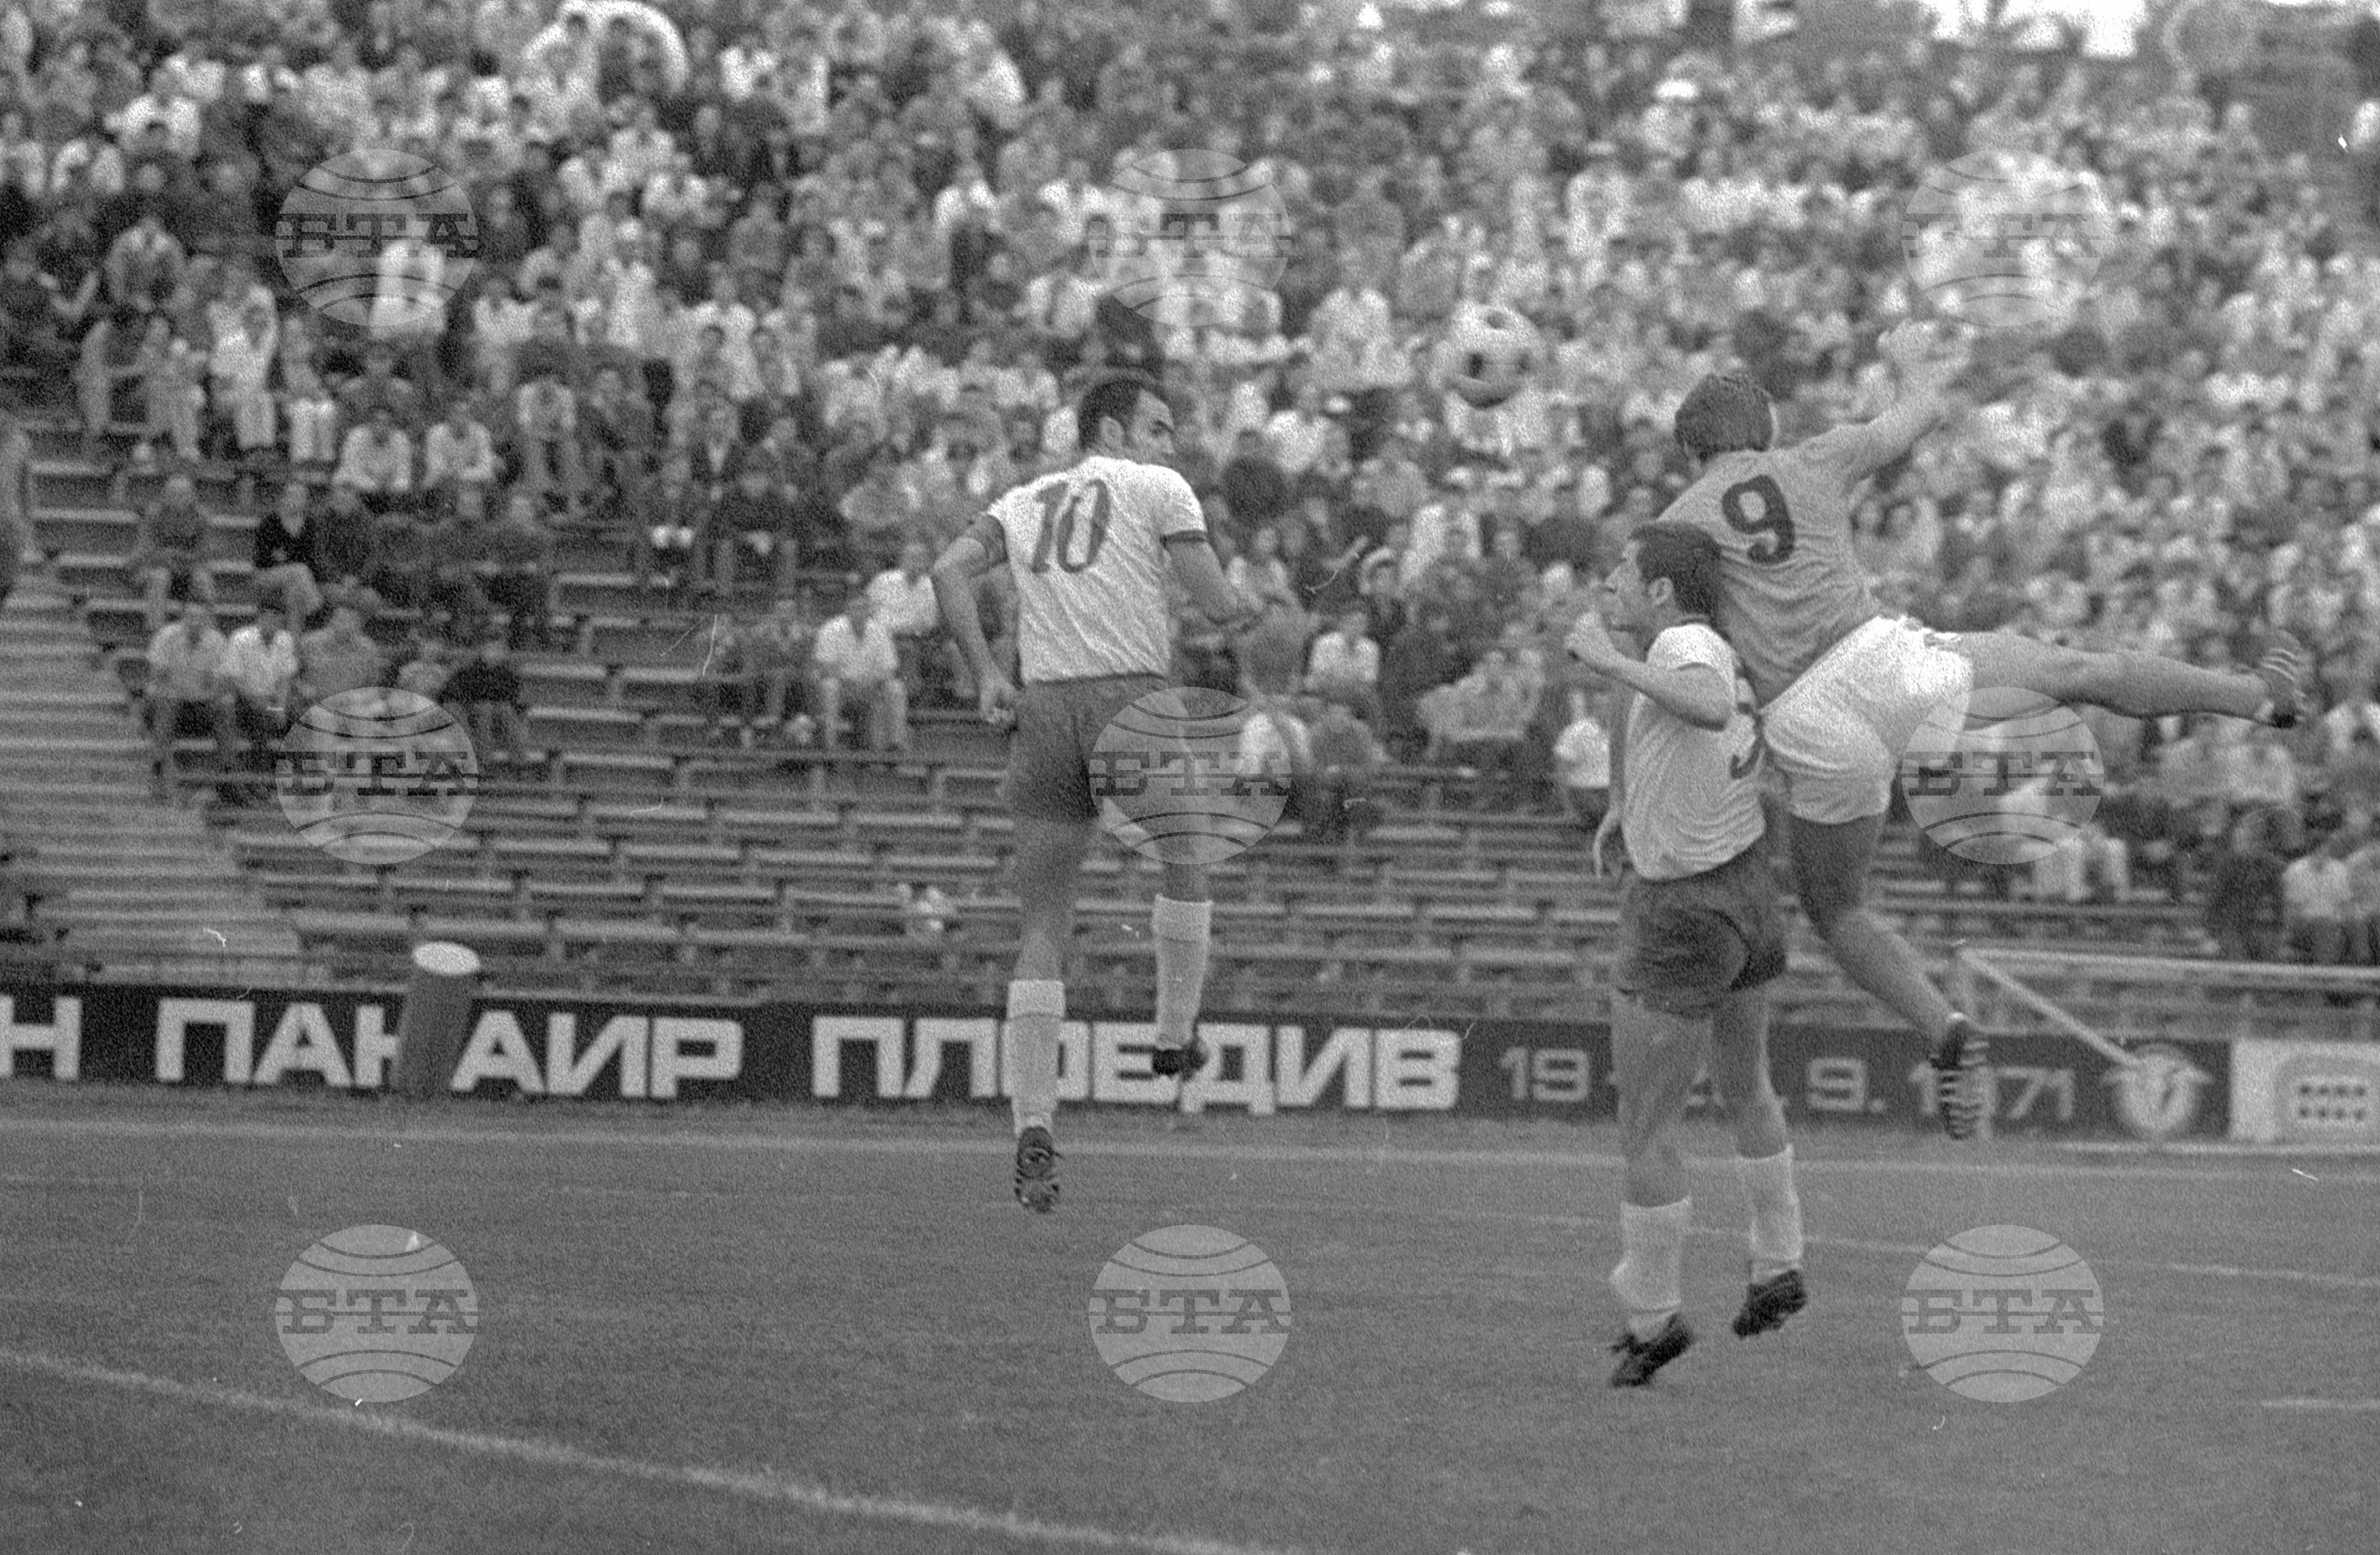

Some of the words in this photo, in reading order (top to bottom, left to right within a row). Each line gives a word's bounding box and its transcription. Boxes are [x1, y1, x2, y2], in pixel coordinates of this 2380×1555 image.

[1030, 478, 1110, 573] 10
[1722, 475, 1795, 564] 9
[1499, 1046, 1590, 1102] 19
[1908, 1060, 2074, 1120] 171
